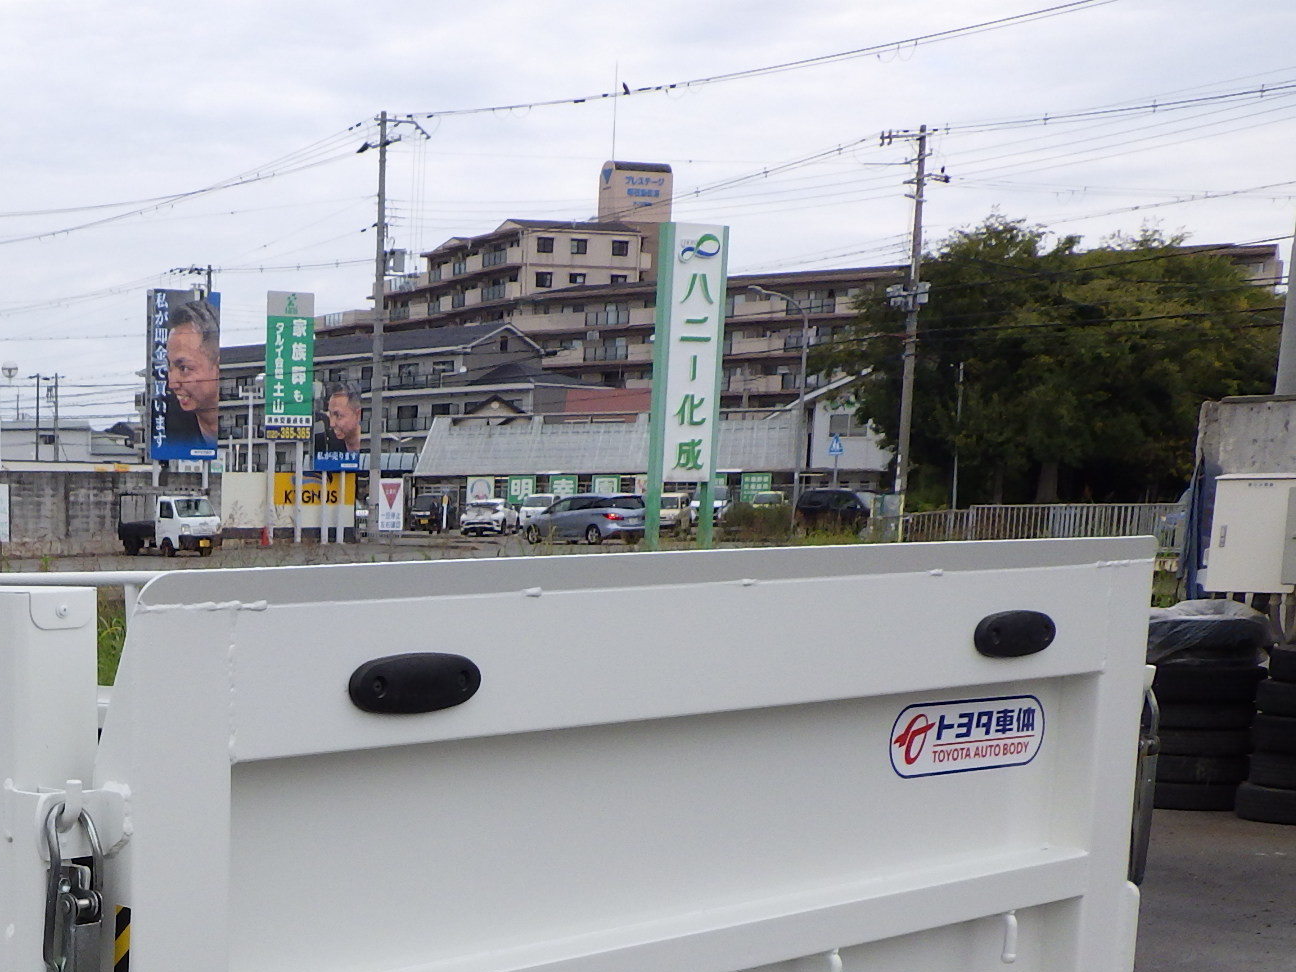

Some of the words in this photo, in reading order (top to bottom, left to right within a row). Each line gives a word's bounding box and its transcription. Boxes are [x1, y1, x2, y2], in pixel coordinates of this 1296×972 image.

[153, 292, 169, 448] 私が即金で買います
[936, 707, 1036, 740] トヨタ車体
[932, 747, 971, 763] TOYOTA
[974, 744, 1001, 759] AUTO
[1003, 741, 1029, 755] BODY
